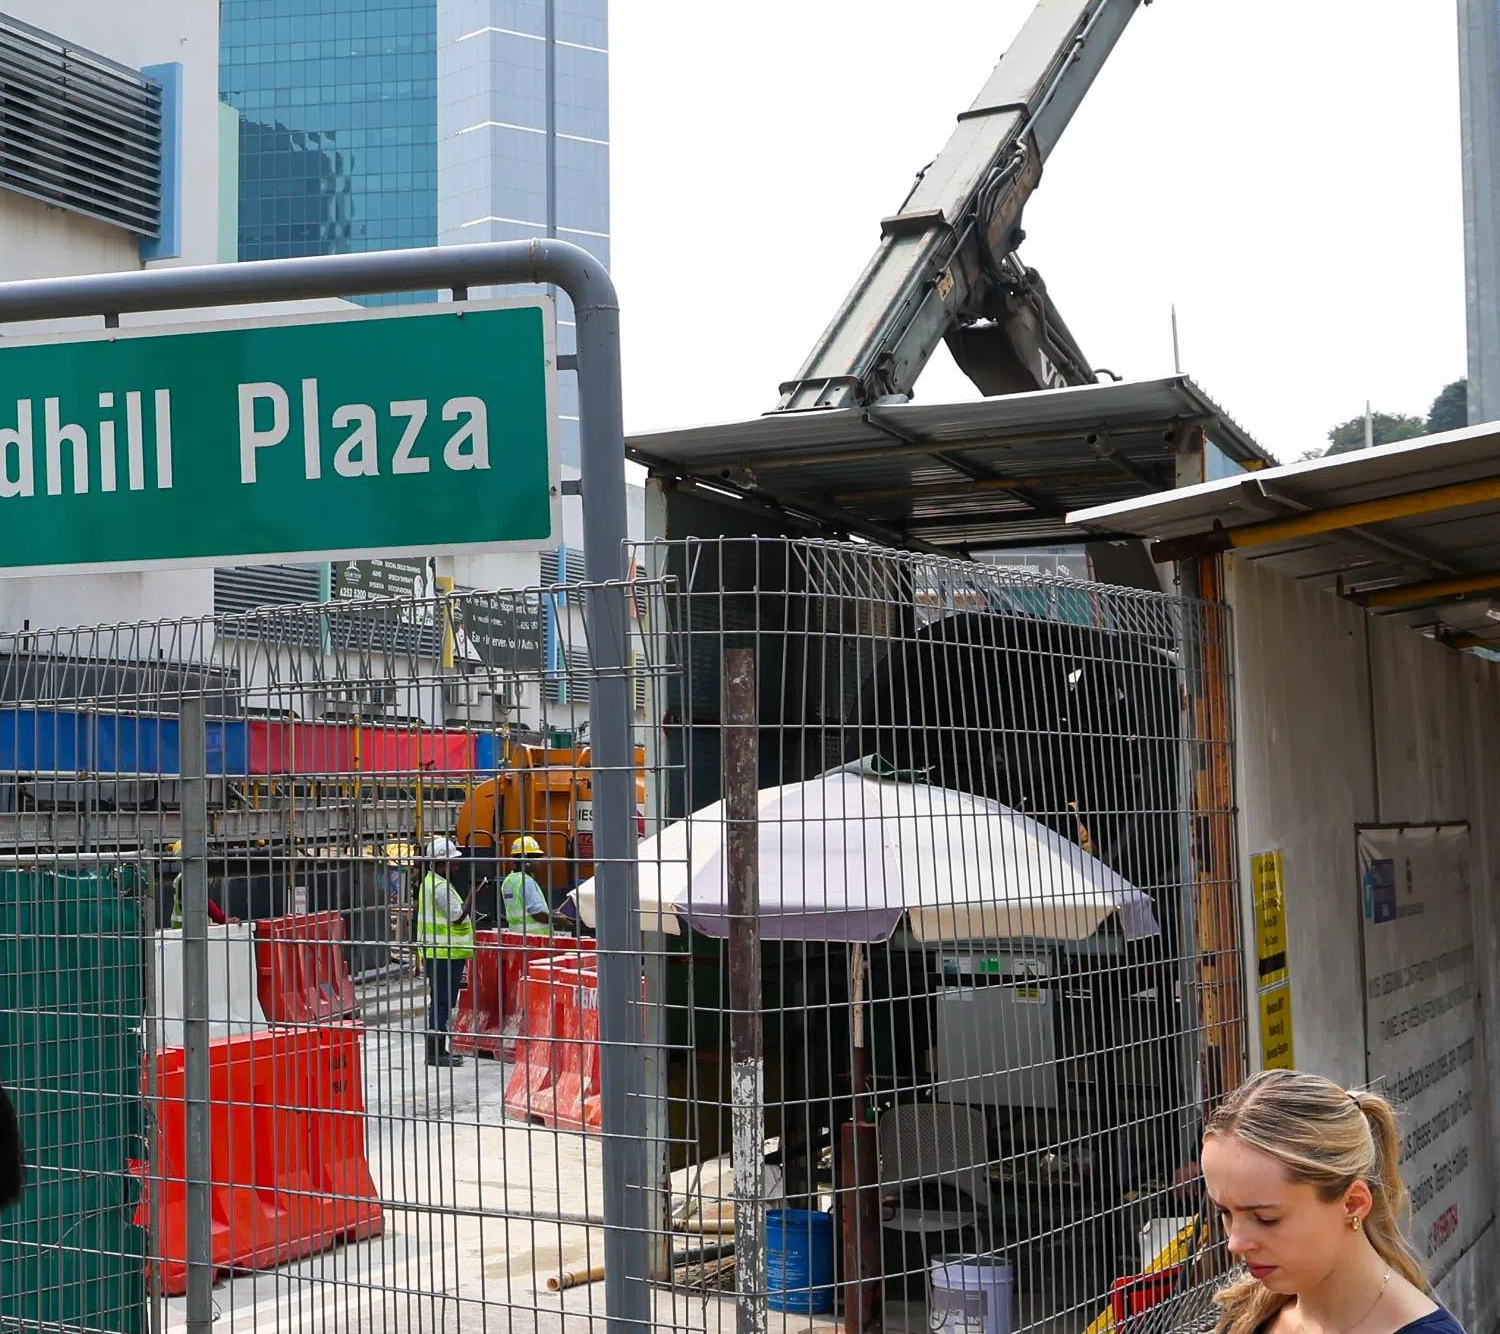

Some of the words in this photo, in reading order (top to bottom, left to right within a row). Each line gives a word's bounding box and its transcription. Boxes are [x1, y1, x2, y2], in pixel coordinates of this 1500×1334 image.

[238, 377, 491, 485] Plaza
[339, 587, 353, 598] 6252
[353, 588, 367, 599] 5200
